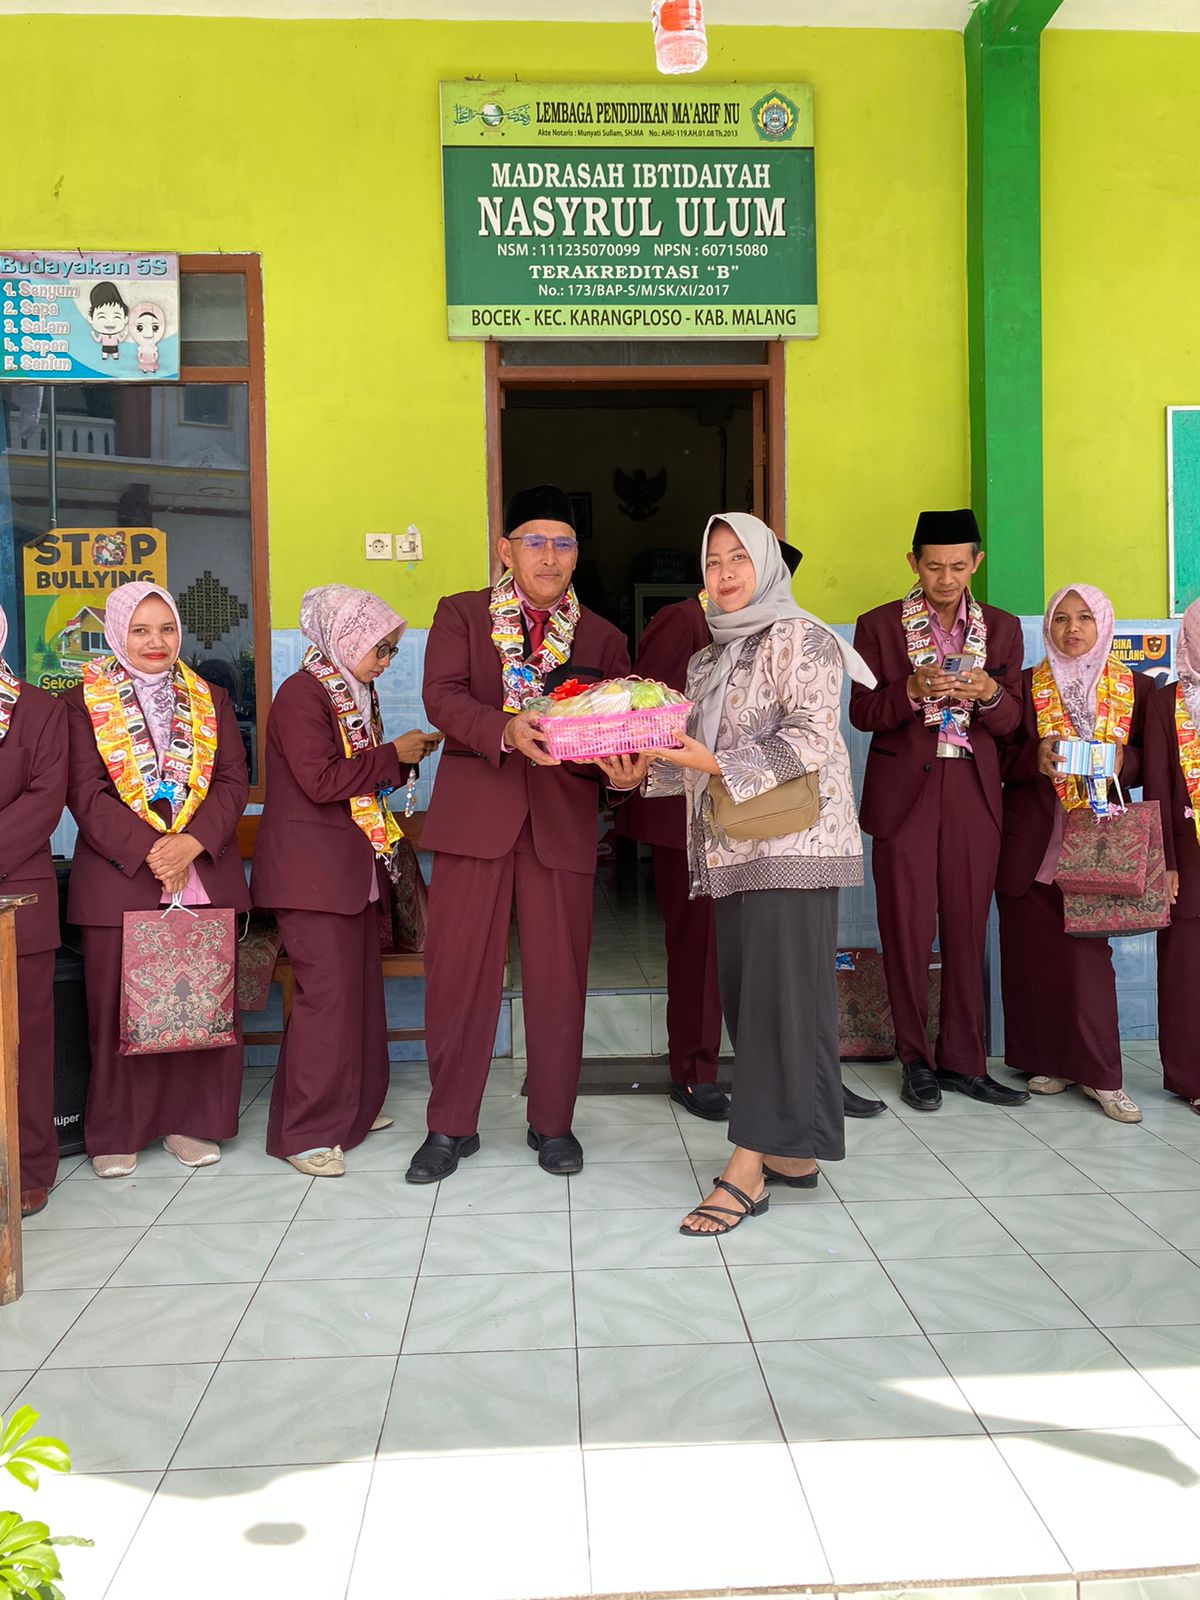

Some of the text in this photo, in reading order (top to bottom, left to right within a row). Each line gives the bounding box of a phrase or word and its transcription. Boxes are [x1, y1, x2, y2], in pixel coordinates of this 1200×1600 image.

[535, 101, 593, 124] LEMBAGA
[596, 102, 668, 124] PENDIDIKAN
[672, 102, 721, 125] MA'ARIF
[724, 103, 740, 125] NU
[537, 129, 552, 137] Akte
[552, 129, 574, 137] Notaris
[577, 129, 602, 139] Munyati
[602, 129, 624, 138] Sullam,
[491, 162, 771, 189] MADRASAH IBTIDAIYAH
[477, 196, 787, 237] NASYRUL ULUM
[497, 243, 529, 257] NSM
[540, 243, 640, 257] 111235070099
[653, 243, 691, 257] NPSN
[701, 243, 769, 257] 60715080
[0, 256, 168, 278] Budayakan 5S
[528, 265, 739, 279] TERAKREDITASI “B”
[3, 280, 81, 302] 1. Senyum
[538, 284, 730, 297] No.: 173/BAP-S/M/SK/XI/2017
[3, 300, 59, 319] 2. Sapa
[472, 309, 522, 326] BOCEK
[534, 309, 566, 326] KEC.
[570, 309, 682, 326] KARANGPLOSO
[694, 309, 728, 326] KAB.
[732, 309, 797, 326] MALANG
[4, 319, 18, 334] 3.
[21, 336, 69, 357] Sopan
[4, 354, 72, 371] 5. Santun
[36, 570, 156, 589] BULLYING
[491, 591, 514, 607] ABC
[902, 602, 924, 619] ABC
[493, 625, 520, 635] ABC
[907, 637, 931, 652] ABC
[538, 647, 561, 668] ABC
[314, 665, 335, 680] ABC
[337, 700, 355, 714] ABC
[352, 737, 370, 751] ABC
